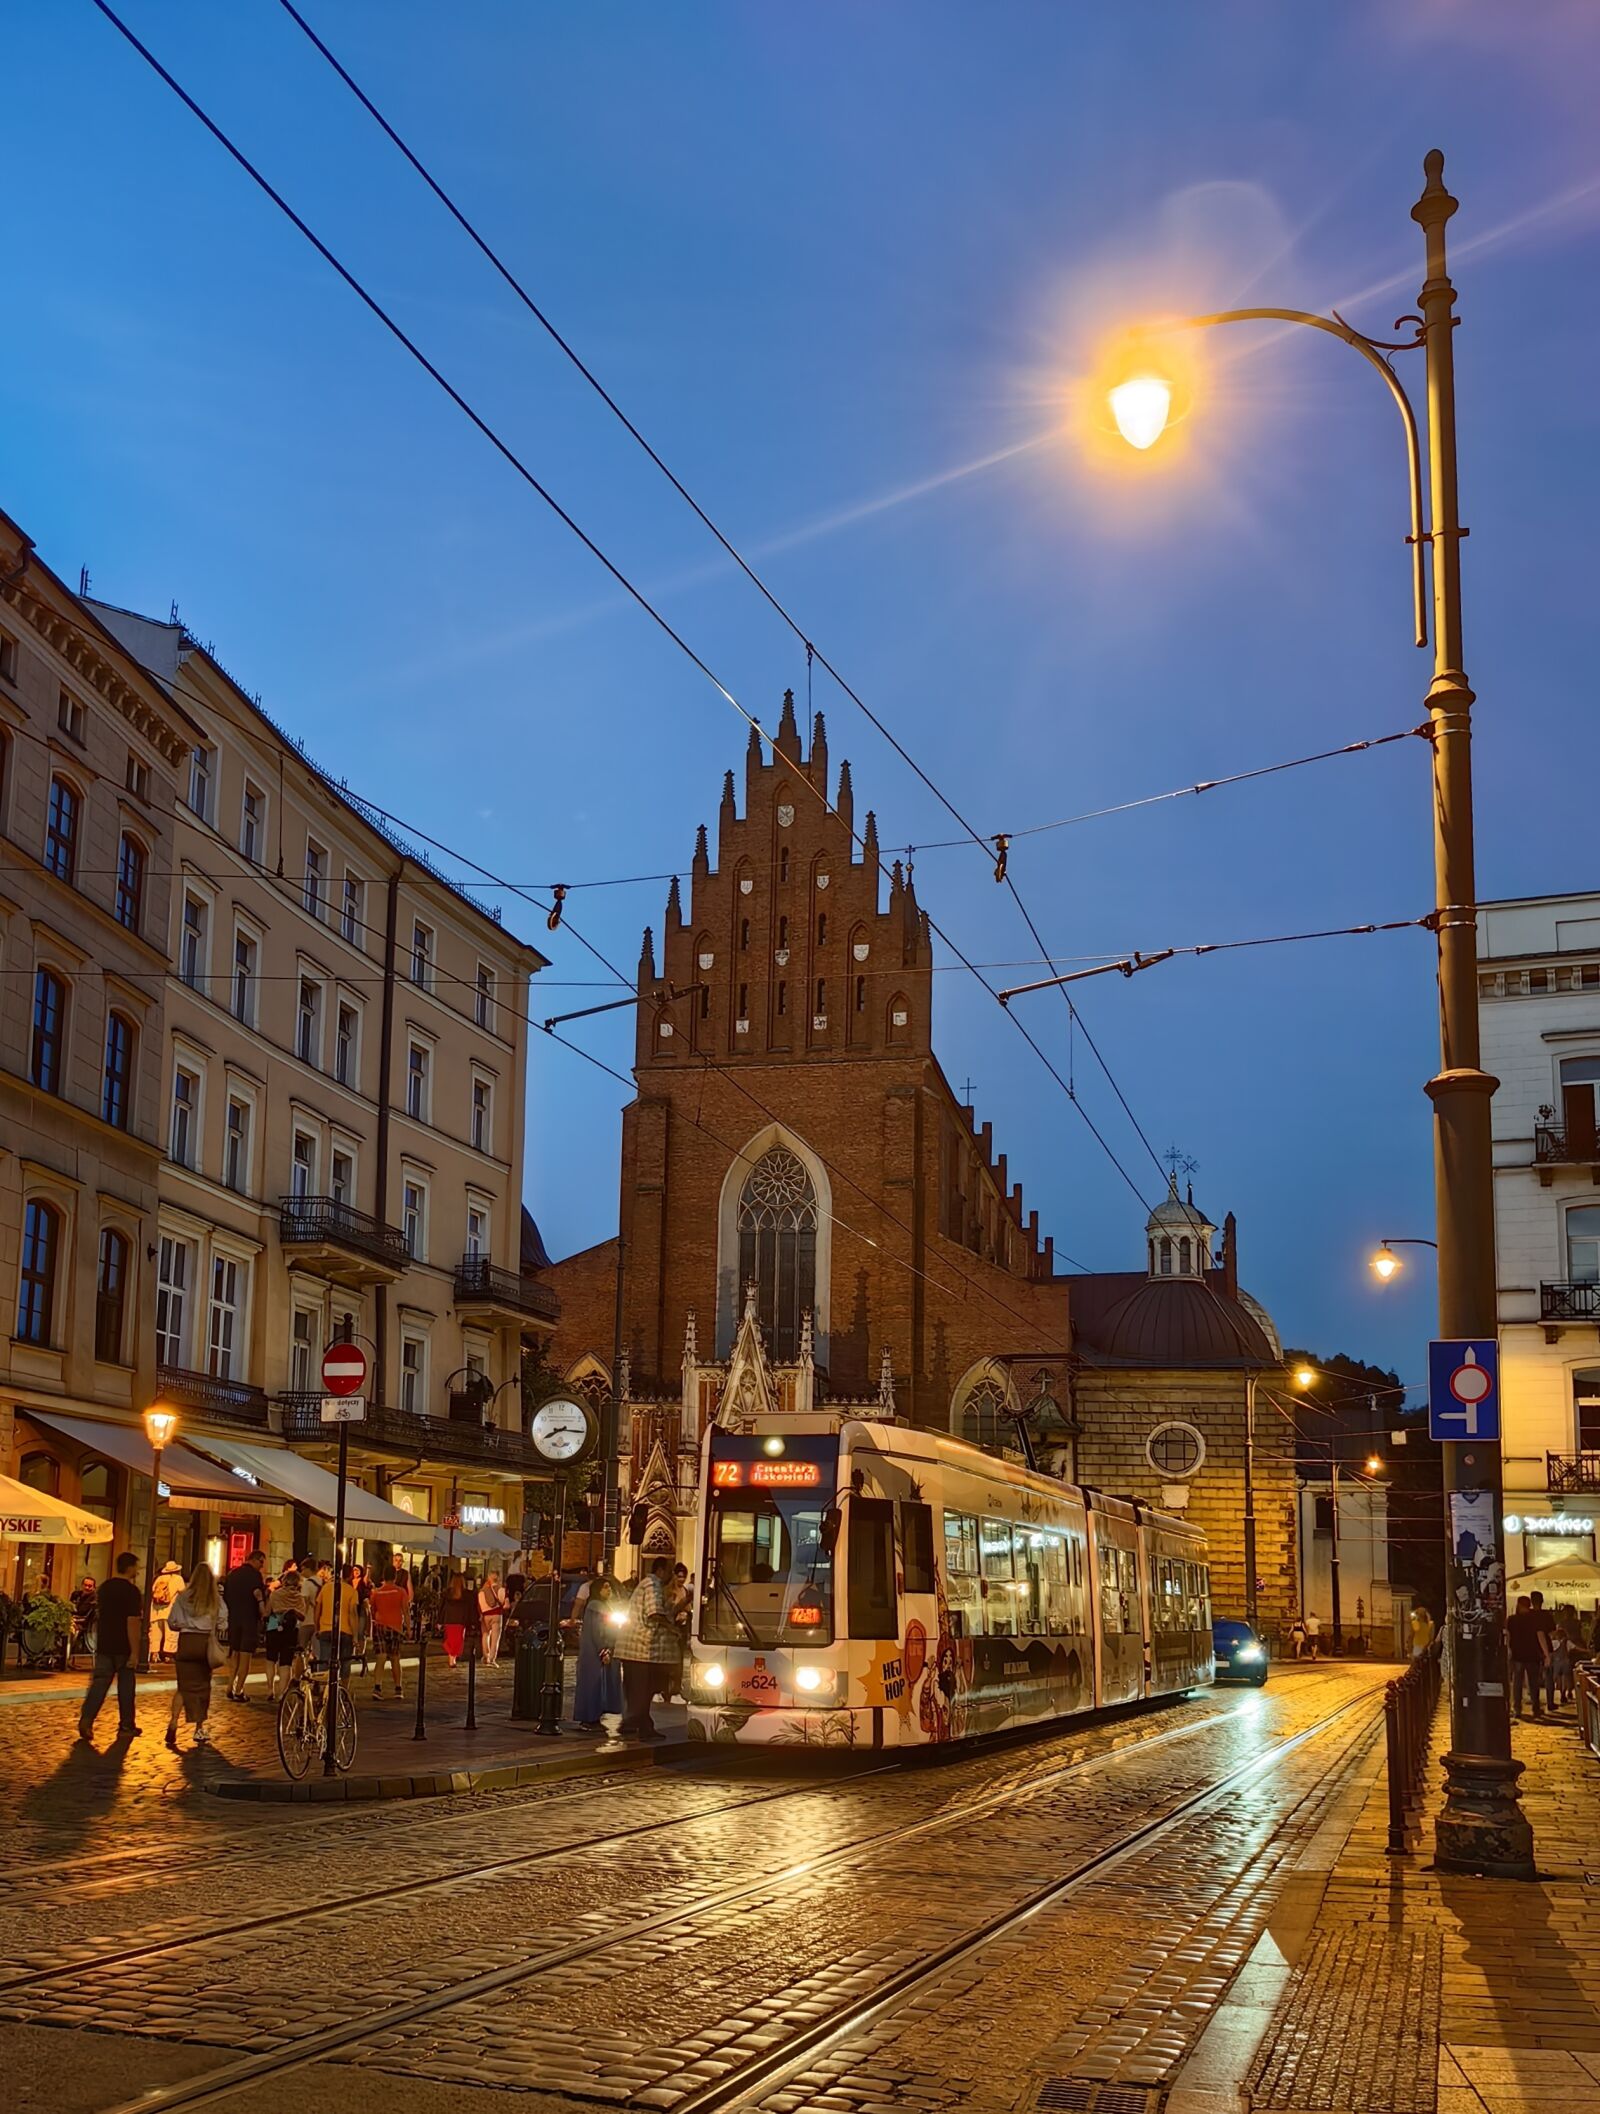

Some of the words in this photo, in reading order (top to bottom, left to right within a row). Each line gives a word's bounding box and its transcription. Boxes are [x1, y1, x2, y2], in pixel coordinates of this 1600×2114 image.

[718, 1464, 738, 1481] 72
[882, 1658, 903, 1681] HEJ
[884, 1678, 906, 1701] HOP
